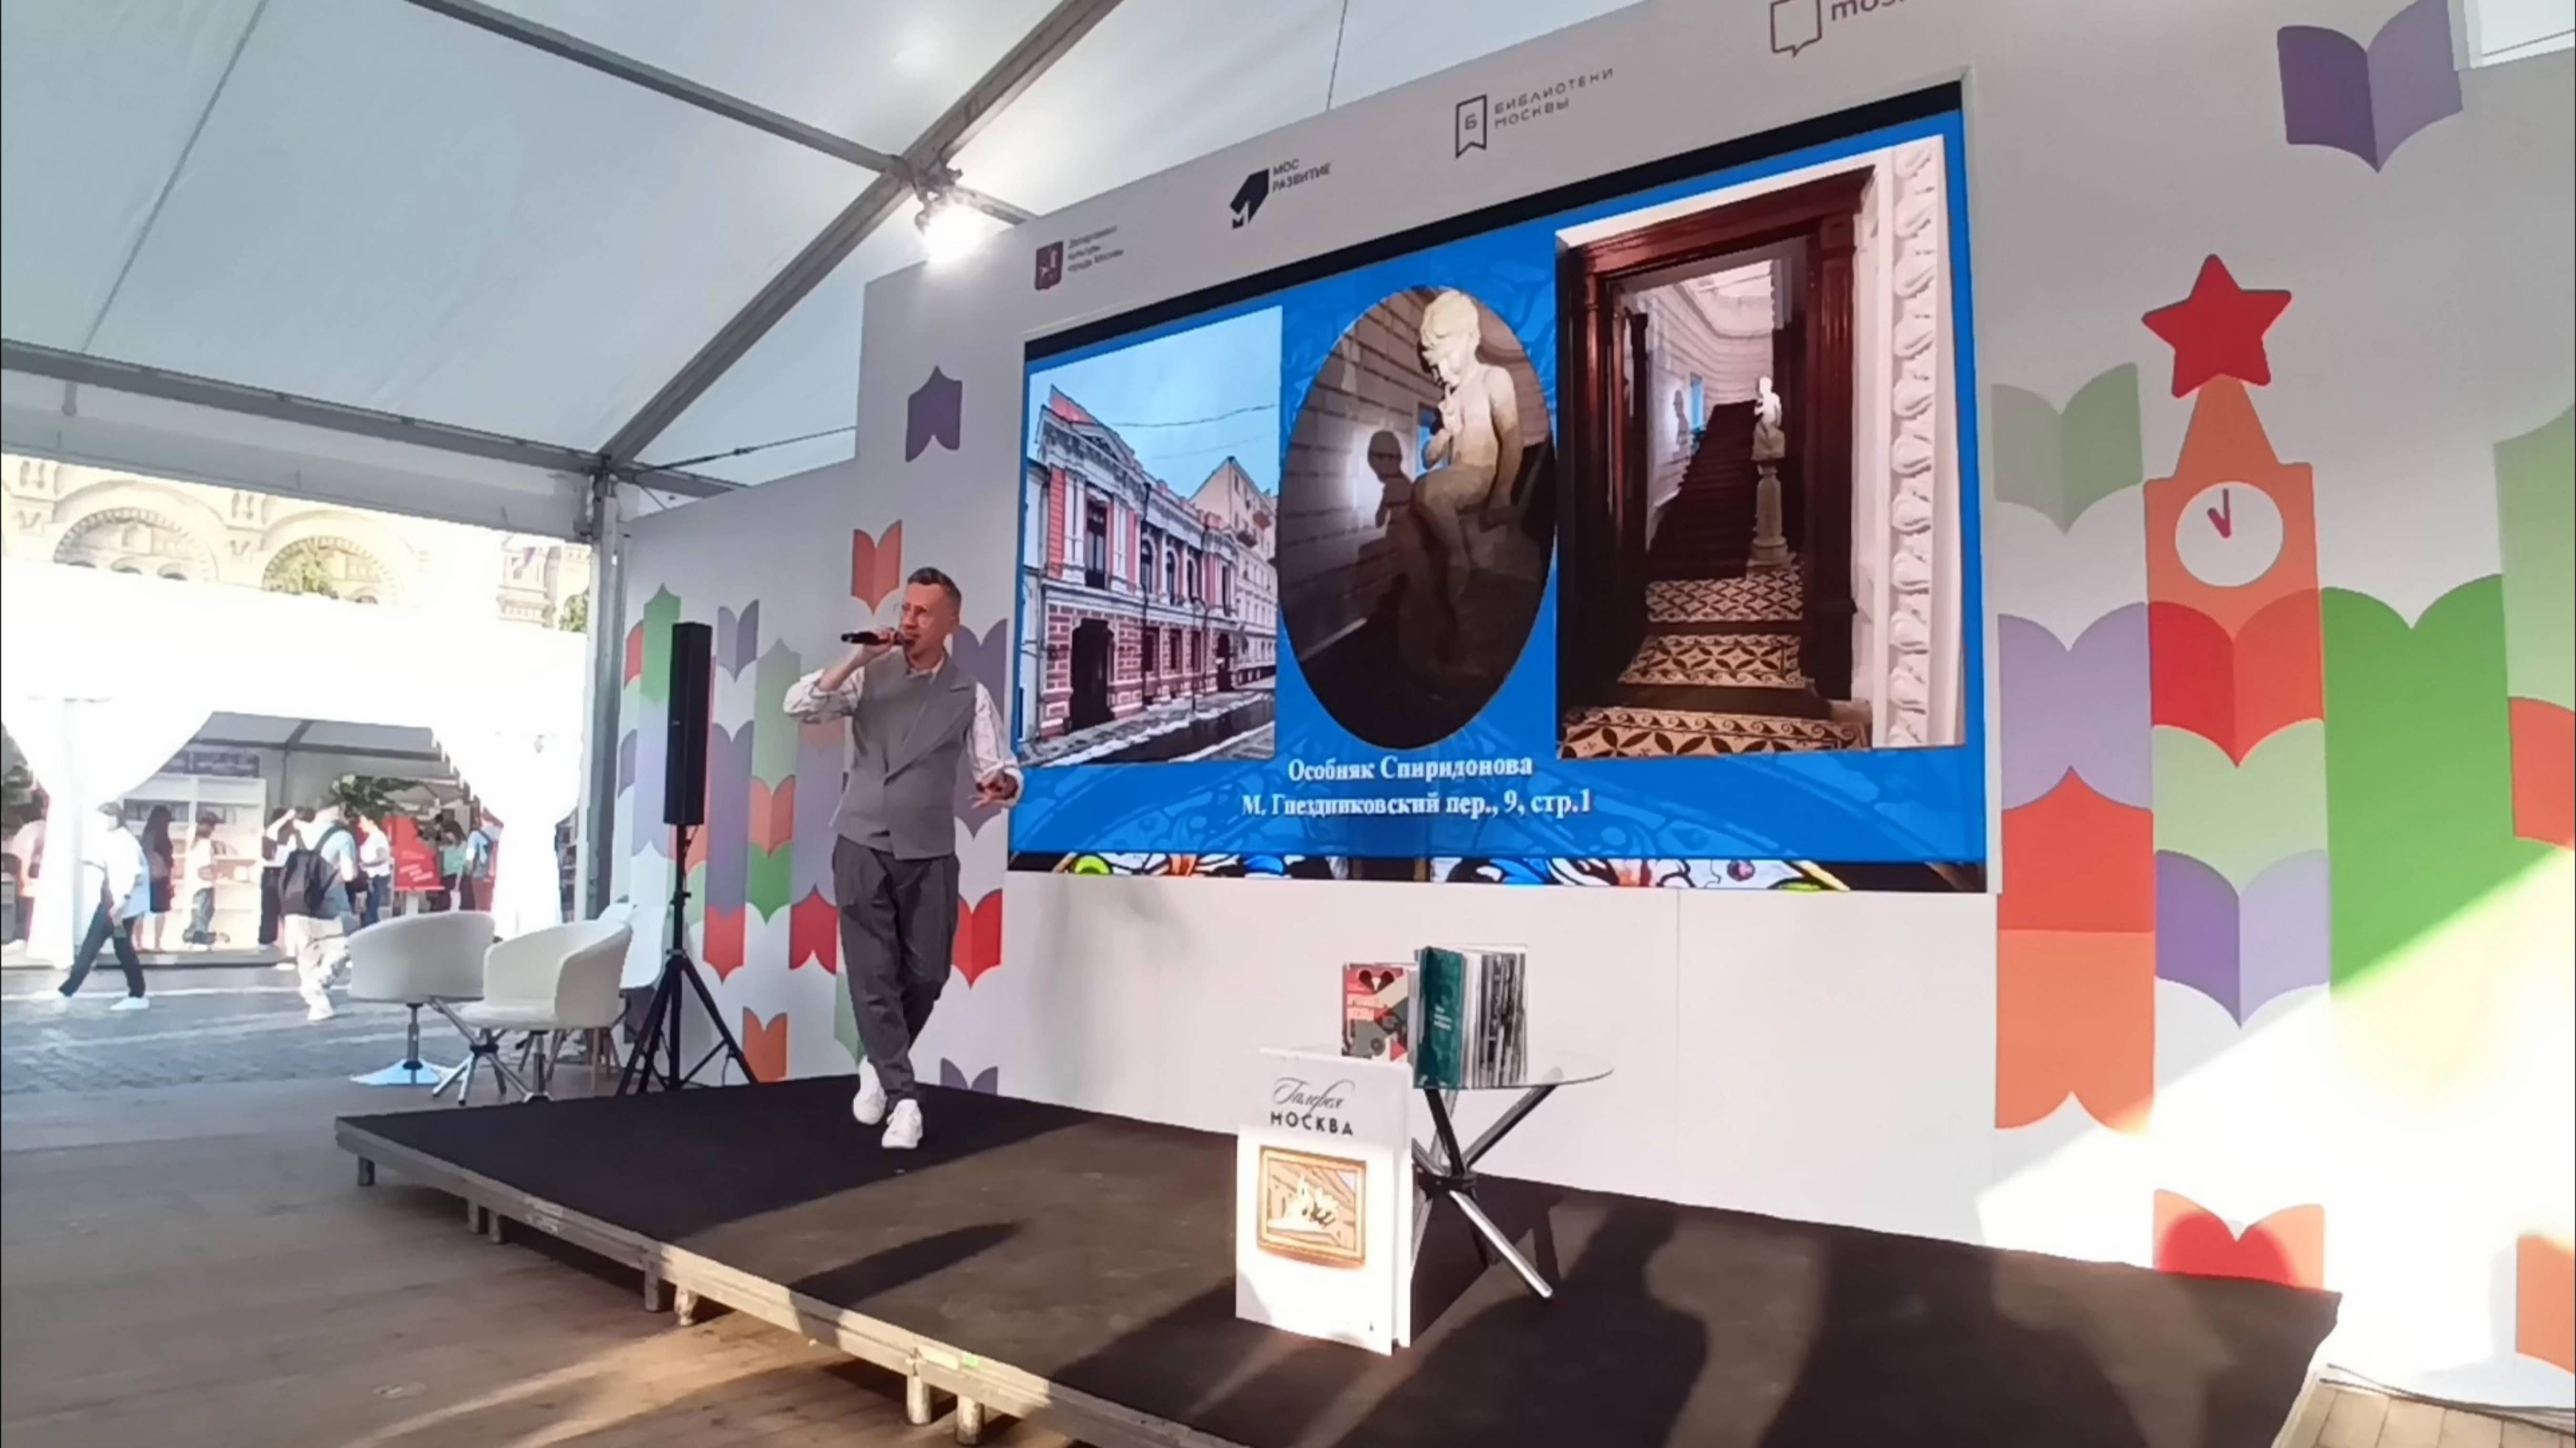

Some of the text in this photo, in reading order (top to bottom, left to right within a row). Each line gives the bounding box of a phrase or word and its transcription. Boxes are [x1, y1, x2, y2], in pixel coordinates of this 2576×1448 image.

[1494, 97, 1569, 129] МОСКВЫ
[1272, 158, 1299, 176] МОС
[1288, 755, 1533, 782] Особняк Спиридонова
[1241, 788, 1590, 820] М. Гнездниковский пер., 9, стр.1
[1270, 1110, 1353, 1136] МОСКВА
